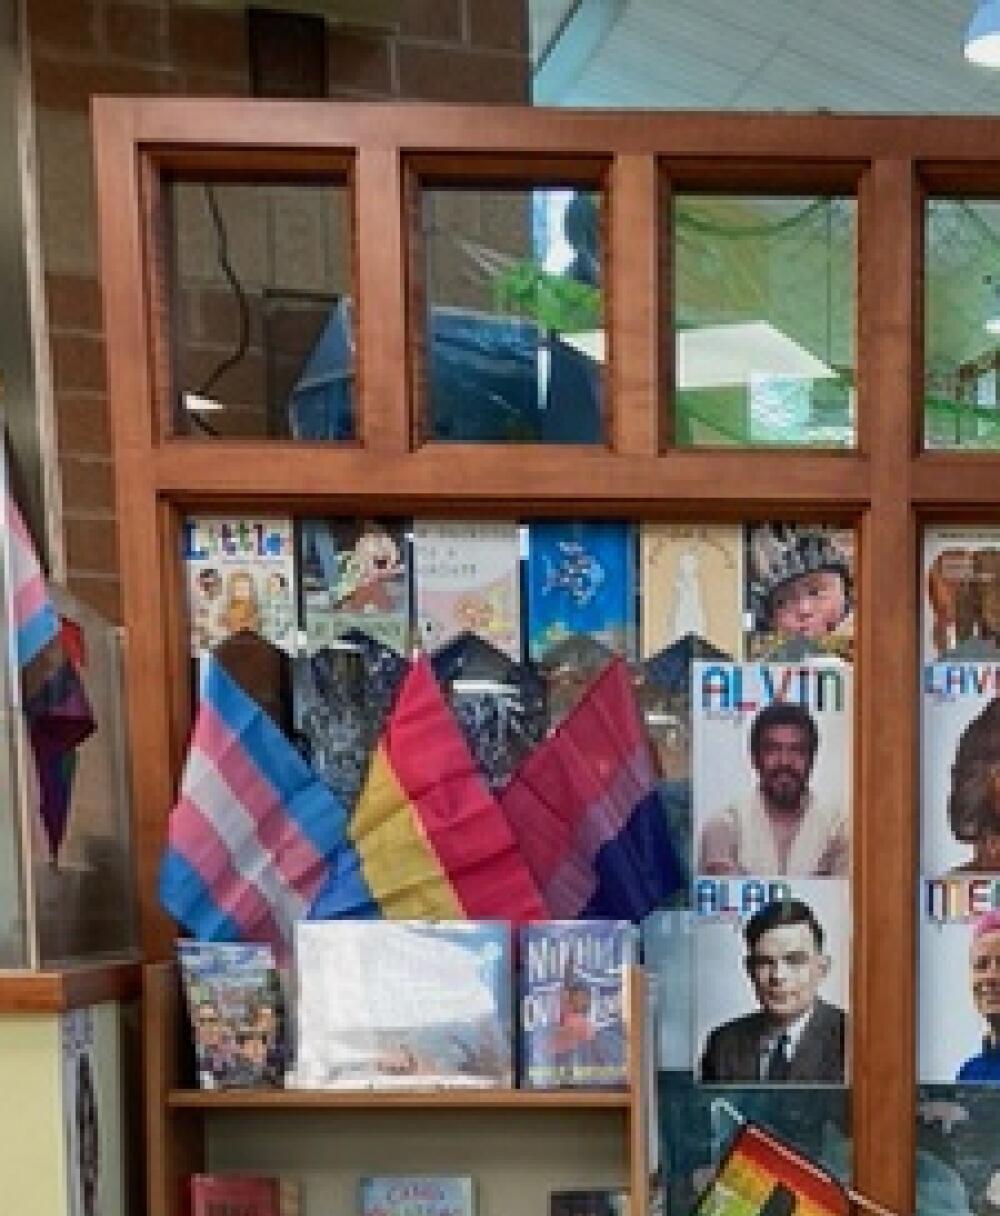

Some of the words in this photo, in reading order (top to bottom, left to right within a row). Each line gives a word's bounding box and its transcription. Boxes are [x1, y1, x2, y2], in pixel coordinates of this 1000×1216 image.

[185, 522, 285, 562] Little
[702, 666, 842, 711] ALVIN
[698, 880, 791, 916] ALAN
